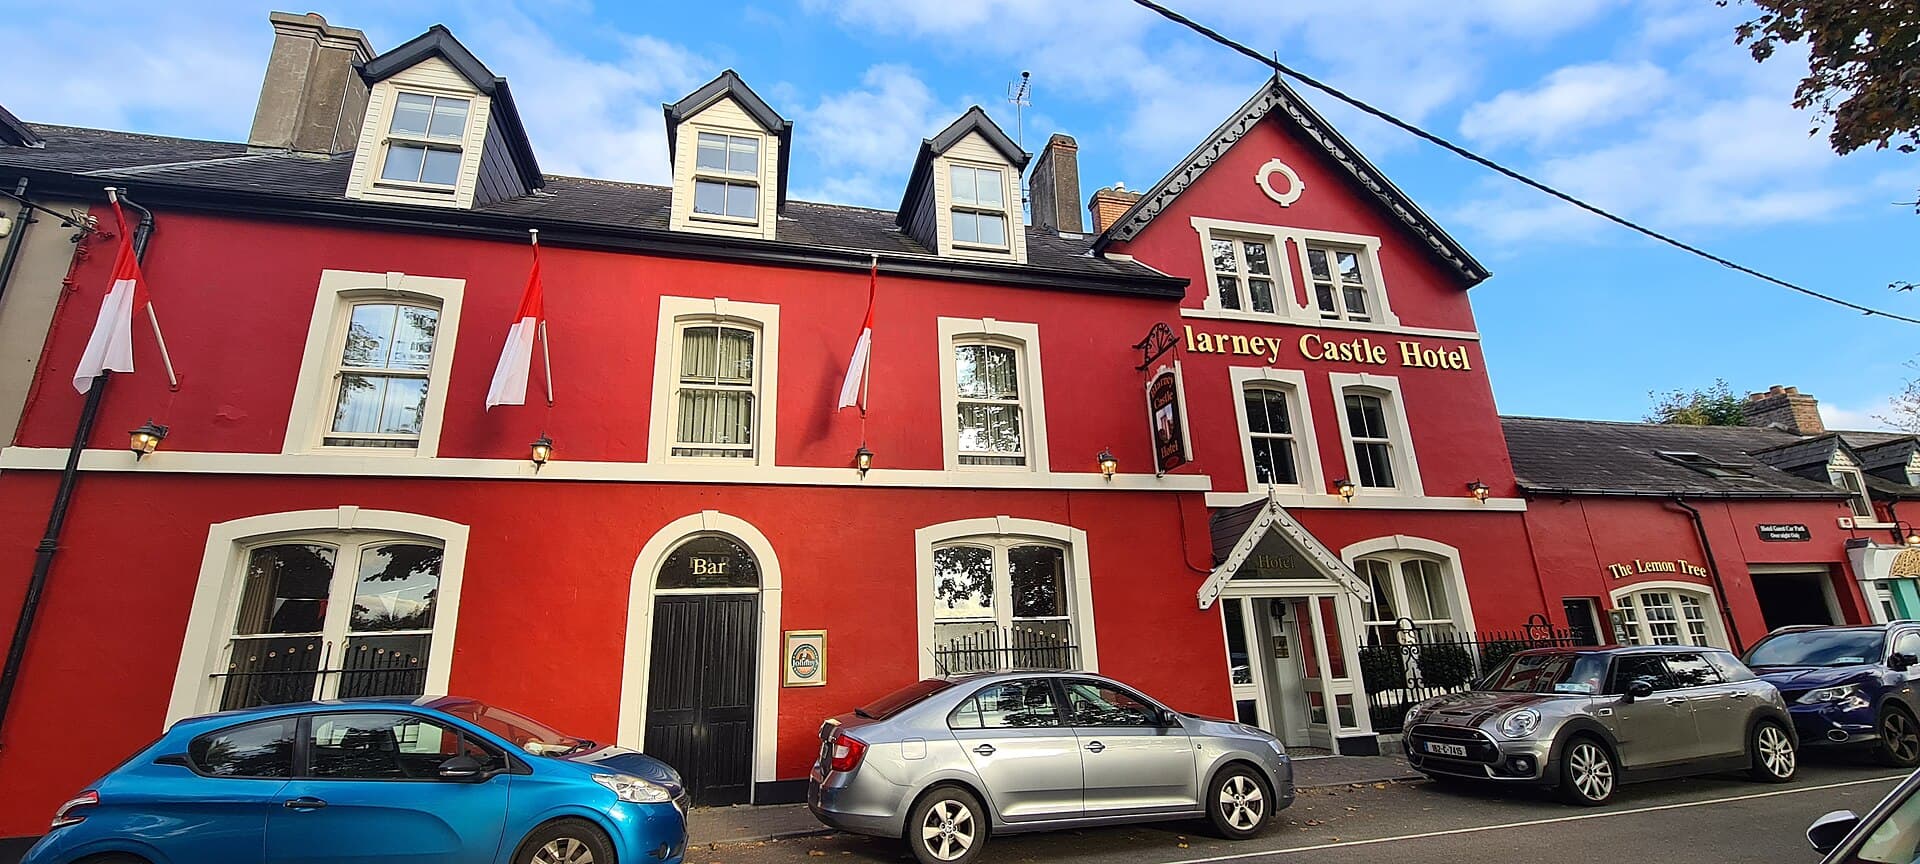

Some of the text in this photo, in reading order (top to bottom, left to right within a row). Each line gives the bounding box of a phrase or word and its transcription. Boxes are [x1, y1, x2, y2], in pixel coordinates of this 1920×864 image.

[1184, 325, 1471, 370] larney Castle Hotel
[1154, 391, 1173, 409] Castle
[1161, 440, 1178, 458] Hotel
[692, 558, 727, 575] Bar
[1258, 554, 1296, 569] Hotel
[1608, 559, 1707, 579] The Lemon Tree
